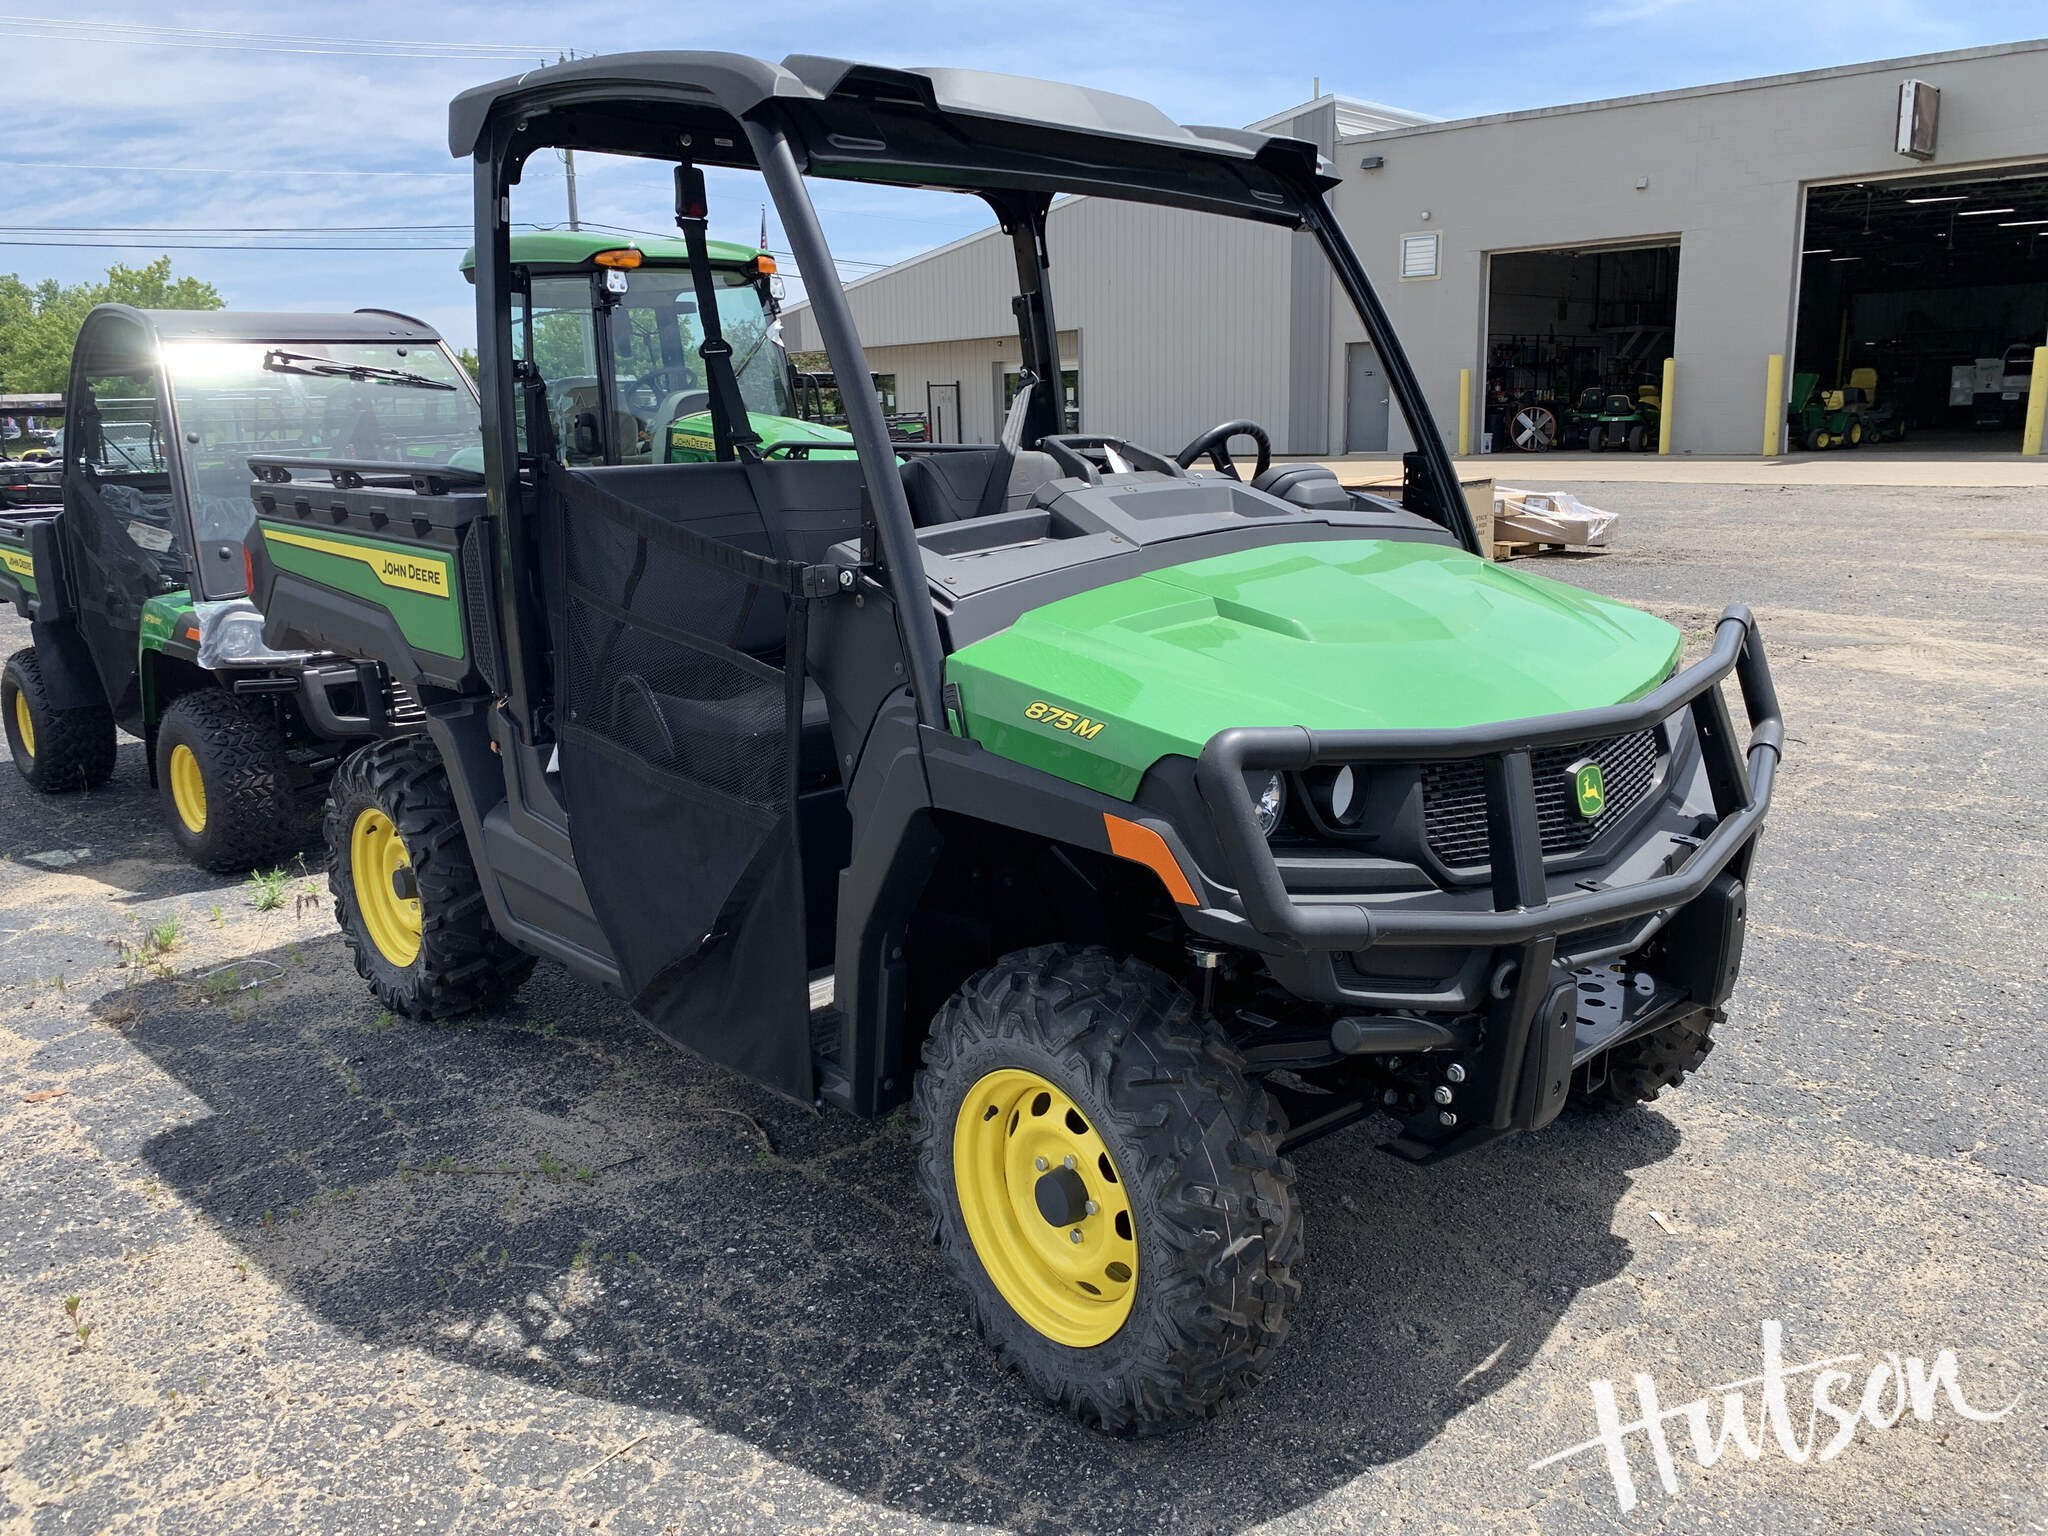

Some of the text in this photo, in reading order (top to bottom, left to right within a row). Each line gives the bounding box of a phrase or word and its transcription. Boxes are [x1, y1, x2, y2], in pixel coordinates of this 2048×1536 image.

[674, 436, 713, 450] JOHN DEERE
[382, 559, 441, 585] JOHN DEERE
[1023, 701, 1107, 740] 875M
